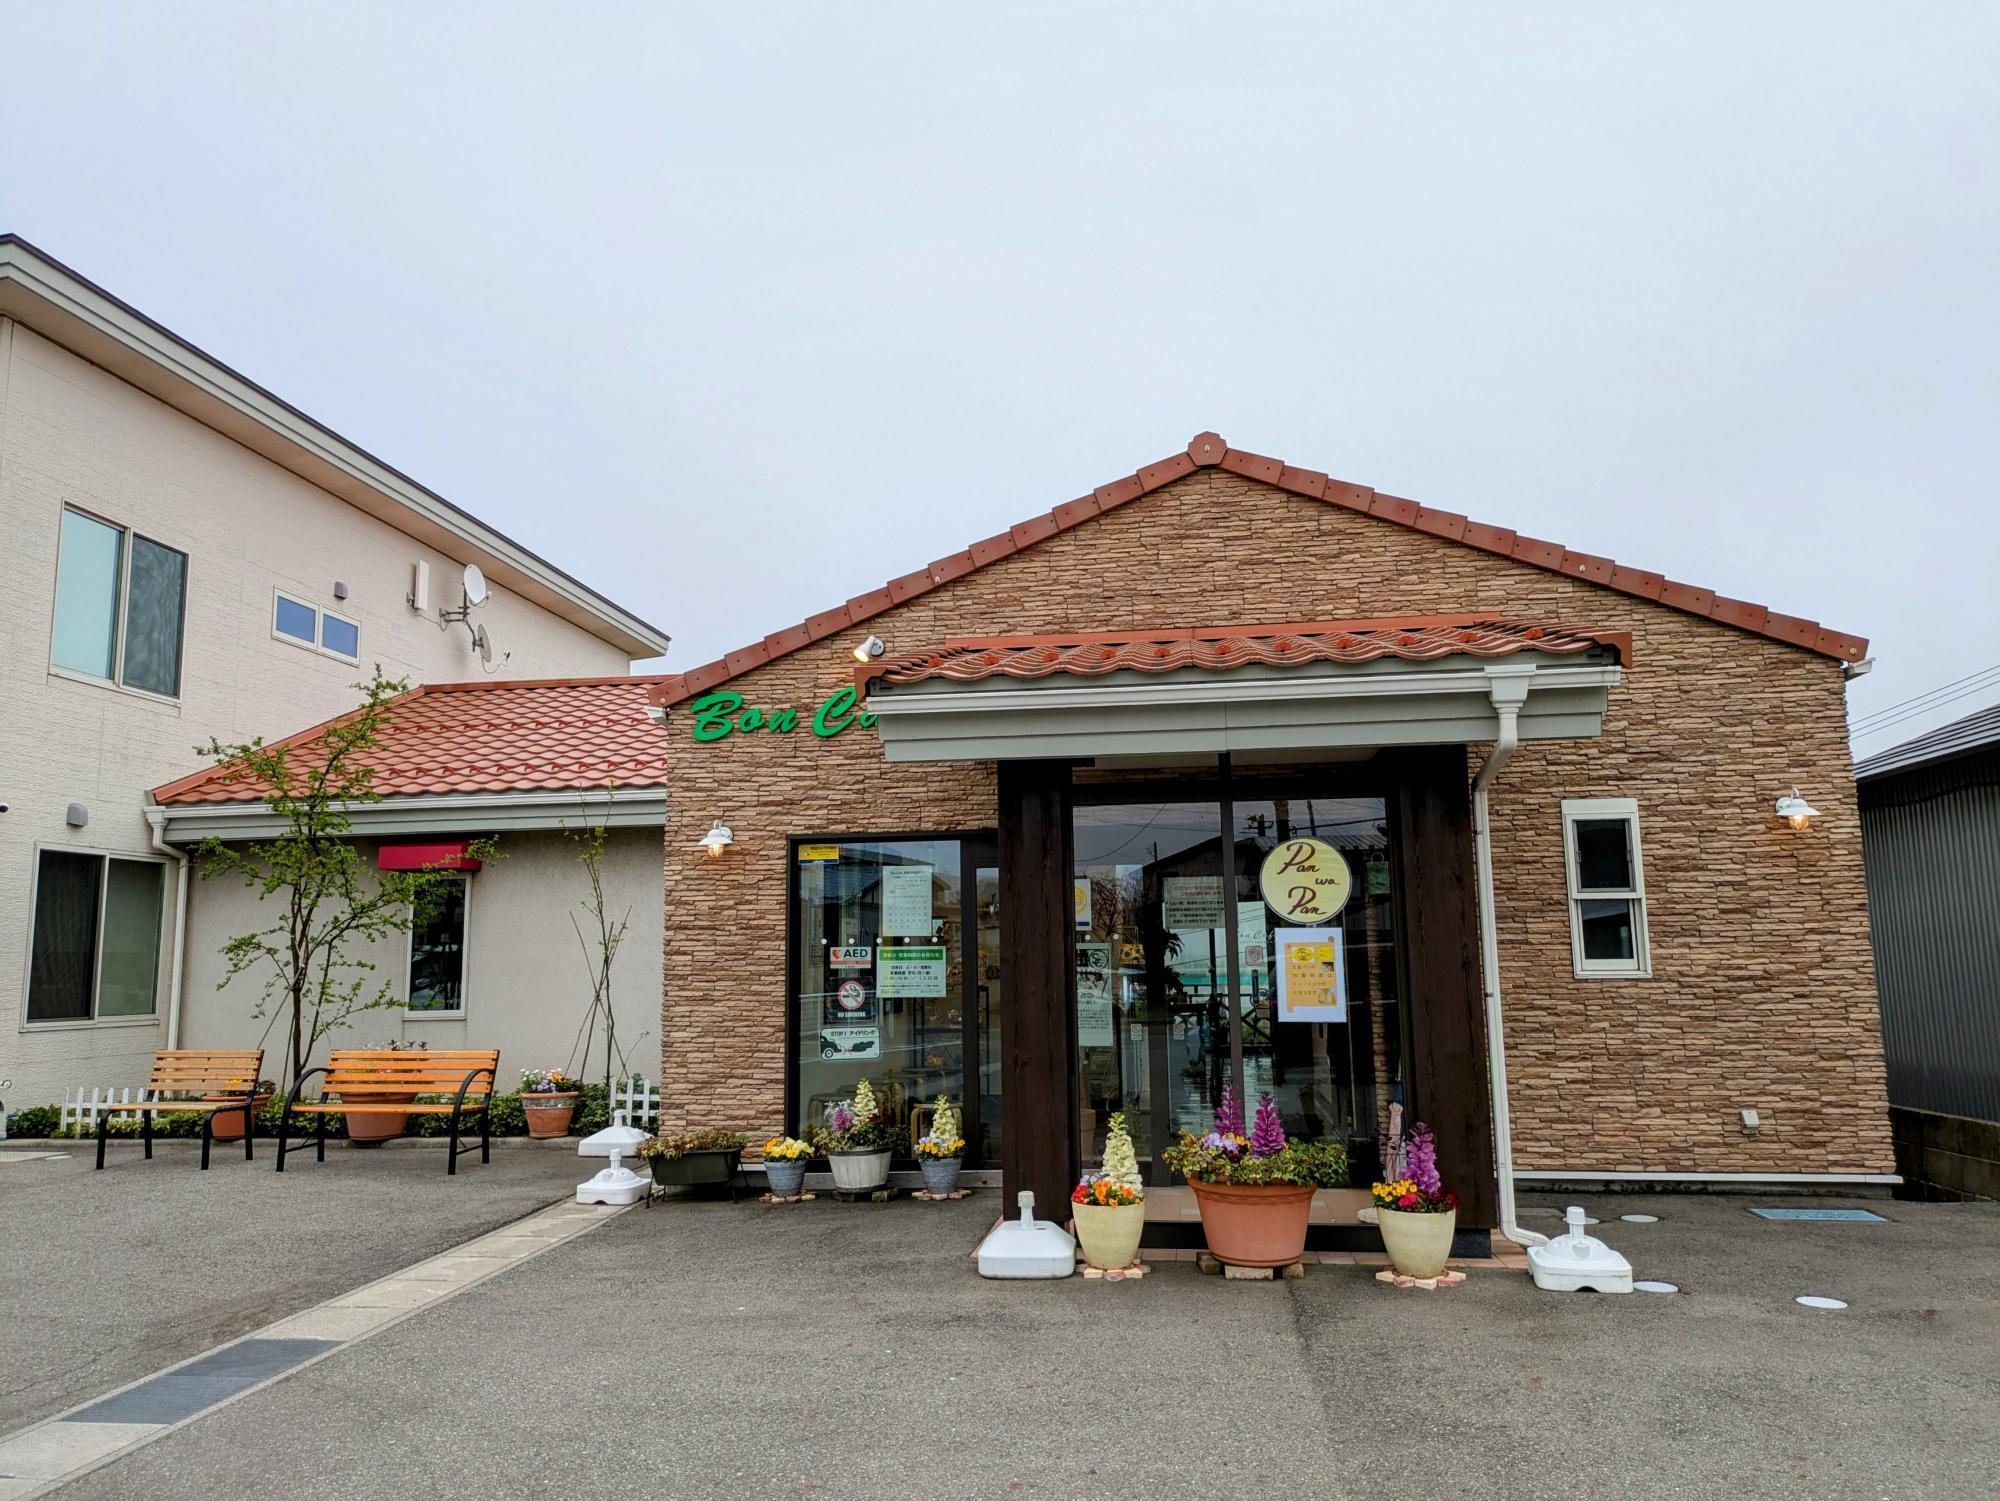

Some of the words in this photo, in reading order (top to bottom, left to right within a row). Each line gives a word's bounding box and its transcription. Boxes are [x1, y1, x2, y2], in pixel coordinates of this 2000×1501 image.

[690, 691, 800, 742] Bon
[1277, 842, 1320, 875] Pan
[1315, 877, 1340, 885] wa
[1287, 886, 1327, 915] Pan
[843, 949, 868, 958] AED
[849, 1029, 875, 1037] アイドリング
